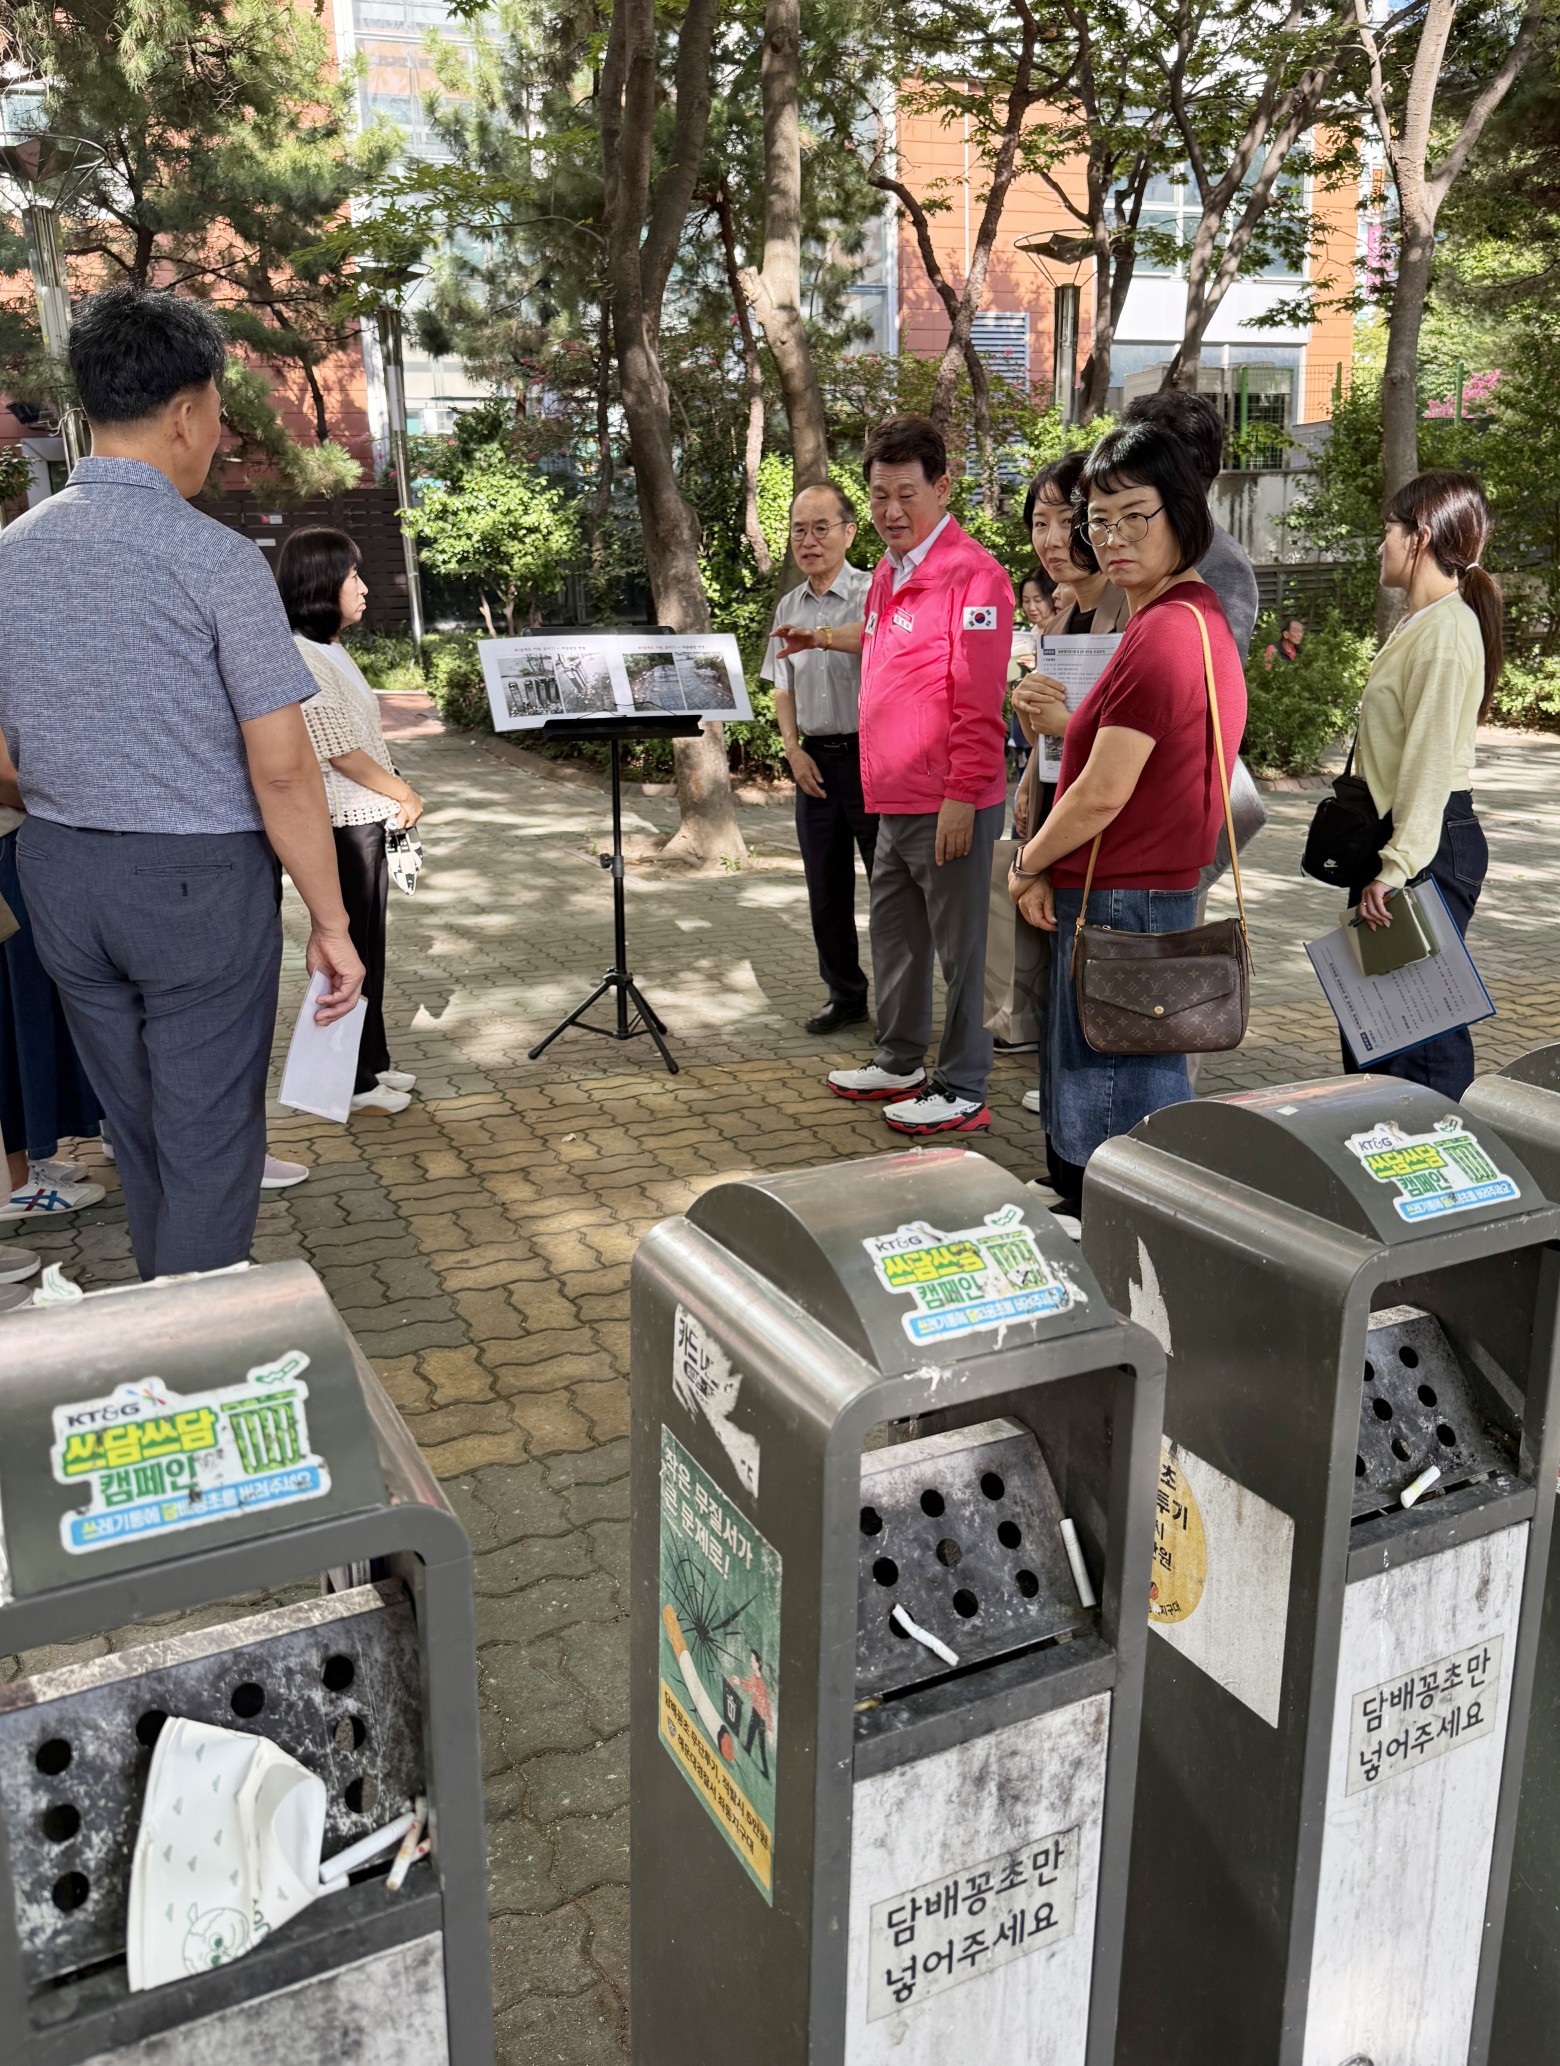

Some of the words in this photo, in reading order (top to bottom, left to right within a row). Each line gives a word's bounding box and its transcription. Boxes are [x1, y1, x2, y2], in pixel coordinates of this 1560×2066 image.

[1358, 1137, 1393, 1151] KT&G
[1365, 1145, 1447, 1179] 쓰담쓰담
[1400, 1170, 1453, 1198] 캠페인
[874, 1235, 923, 1253] KT&G
[883, 1241, 986, 1287] 쓰담쓰담
[917, 1274, 985, 1310] 캠페인
[66, 1402, 140, 1428] KT&G
[63, 1406, 218, 1476] 쓰담쓰담
[99, 1455, 199, 1508] 캠페인
[664, 1446, 692, 1499] 작은
[695, 1482, 754, 1571] 무질서가
[664, 1480, 679, 1518] 큰
[681, 1500, 730, 1581] 문제로!
[664, 1690, 691, 1738] 담배꽁초
[1362, 1647, 1491, 1733] 담배꽁초만
[1360, 1701, 1484, 1782] 넣어주세요
[887, 1838, 1065, 1947] 담배꽁초만
[885, 1902, 1059, 2004] 넣어주세요
